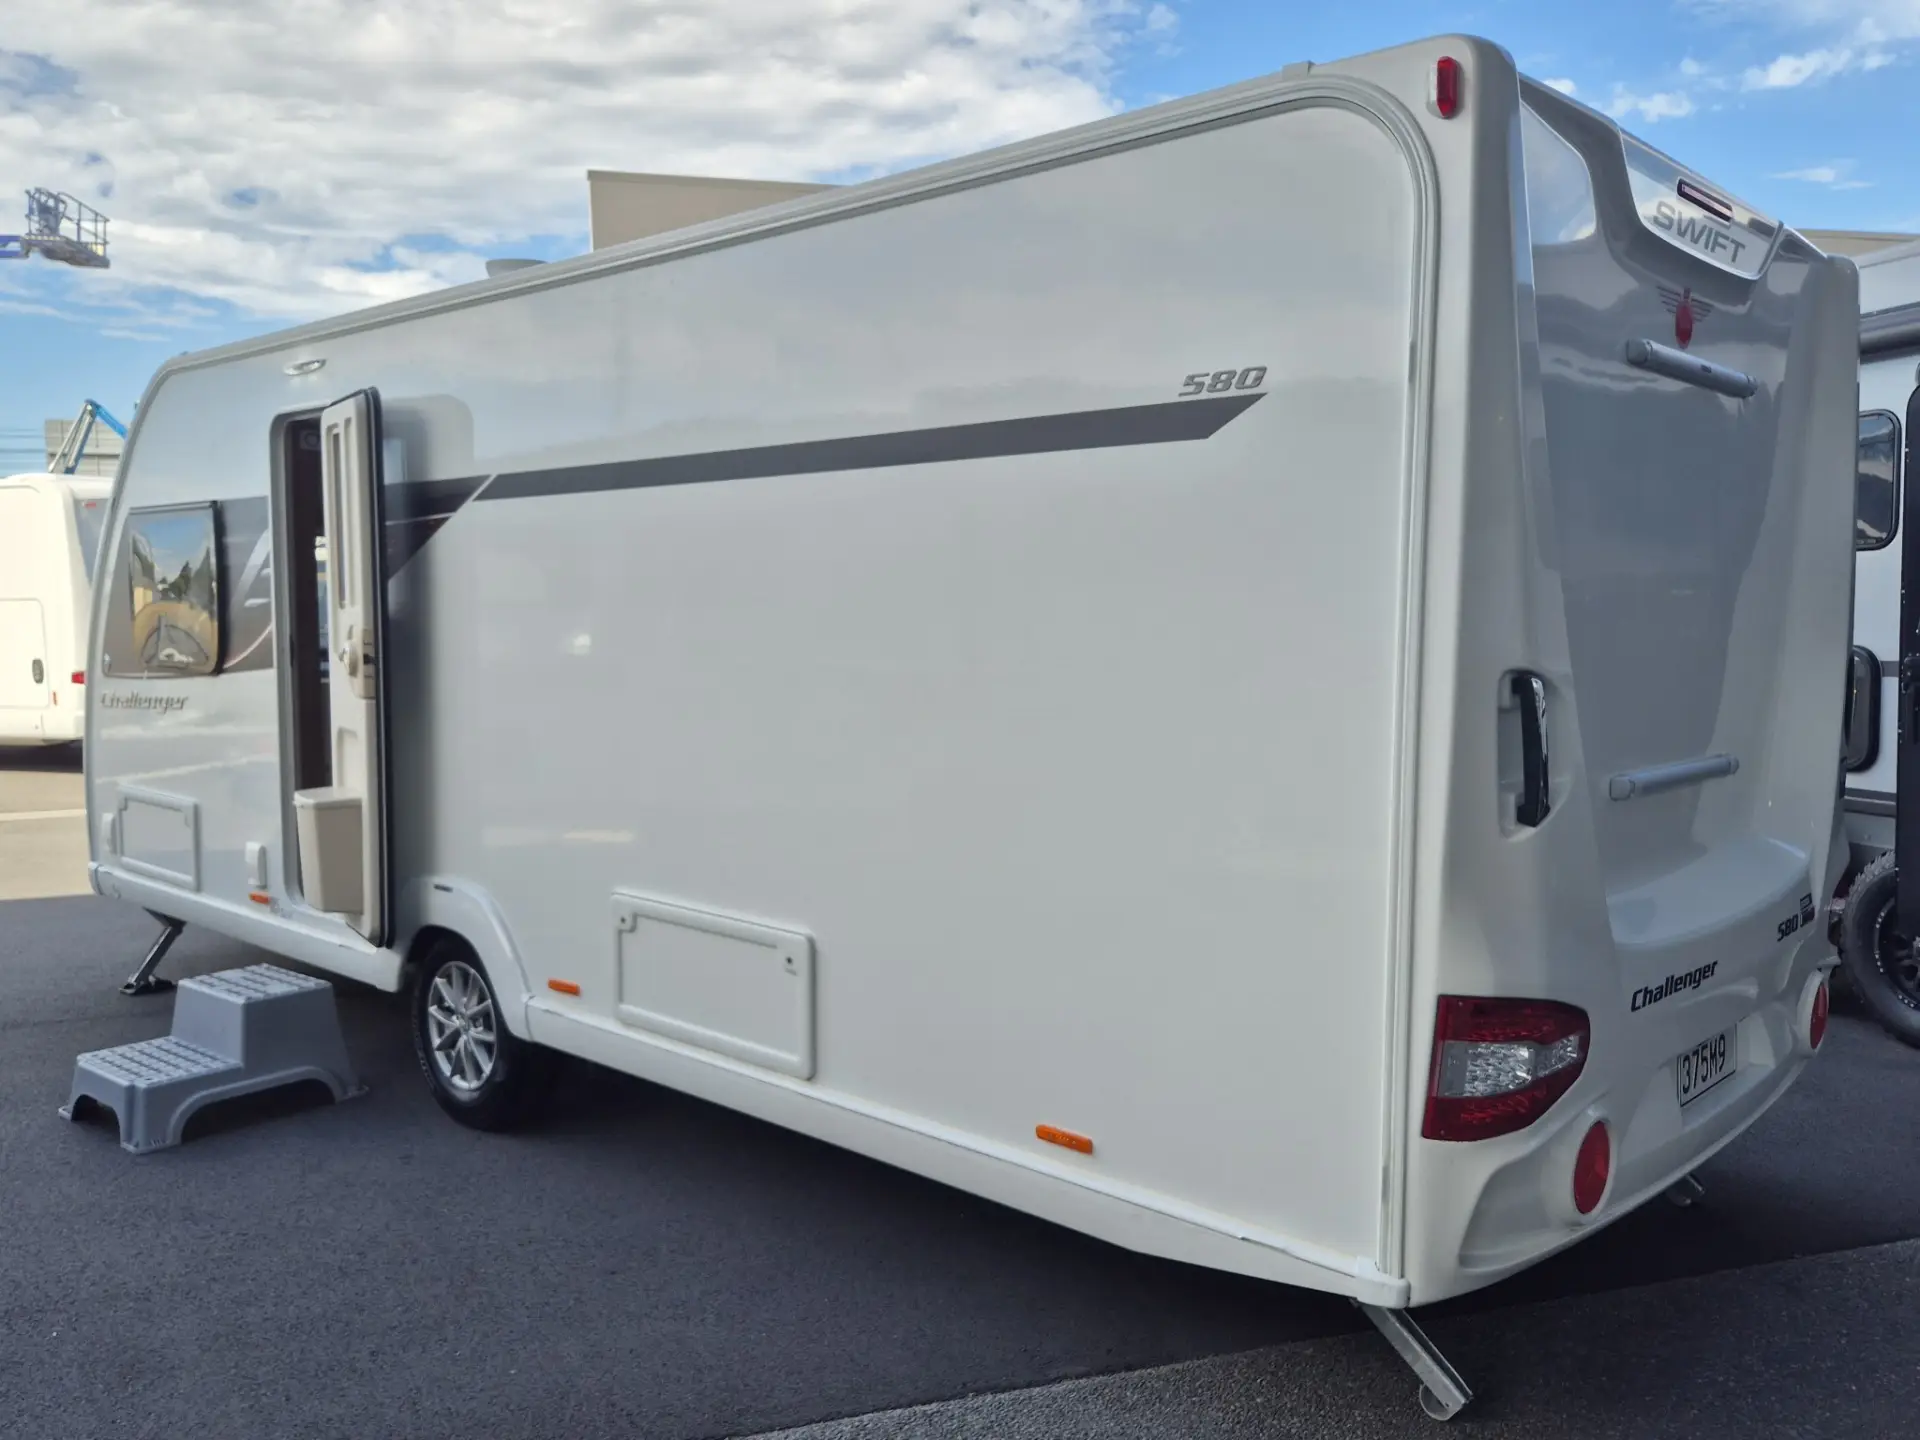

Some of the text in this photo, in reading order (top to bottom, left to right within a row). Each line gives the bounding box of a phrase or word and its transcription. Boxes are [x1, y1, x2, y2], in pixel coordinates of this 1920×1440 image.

[1653, 200, 1746, 264] SWIFT
[1178, 366, 1268, 397] 580
[1777, 912, 1799, 942] 580
[1631, 960, 1718, 1012] Challenger
[1682, 1033, 1726, 1095] 375M9
